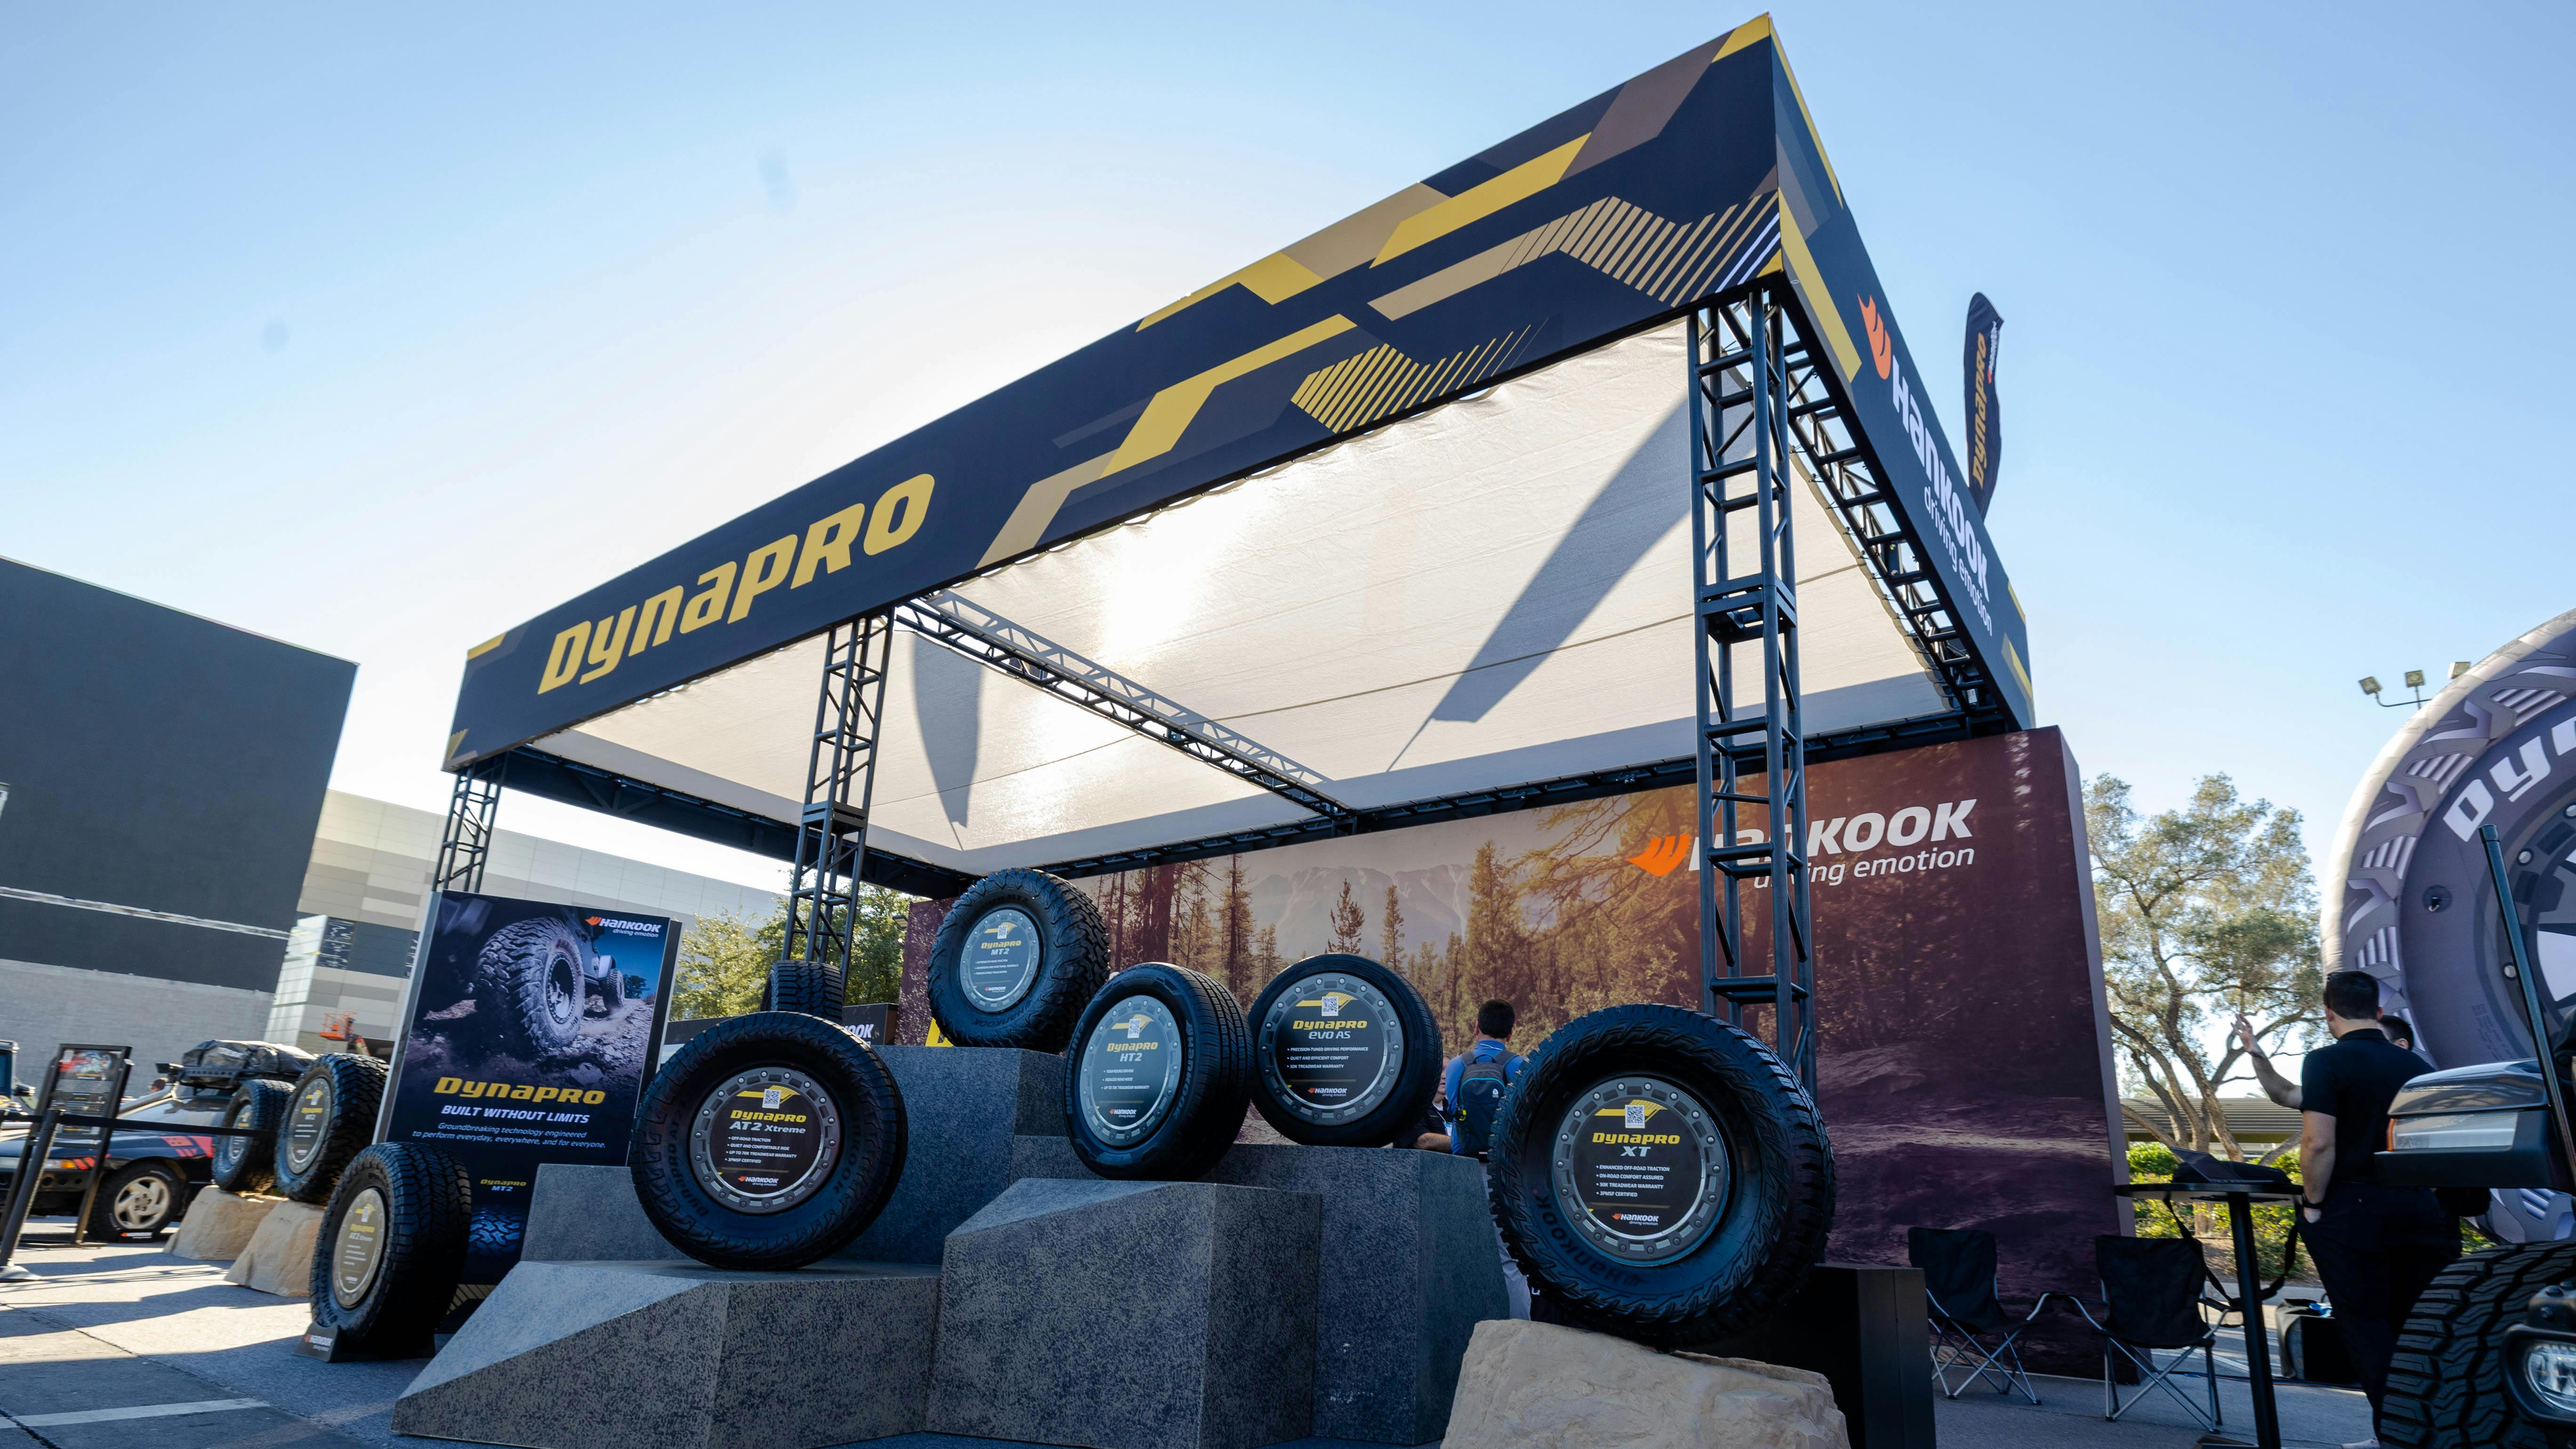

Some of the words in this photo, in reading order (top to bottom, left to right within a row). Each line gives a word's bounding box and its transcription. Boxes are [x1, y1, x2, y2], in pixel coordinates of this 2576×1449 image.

[1923, 485, 1958, 574] driving
[1958, 557, 1993, 637] emotion
[1853, 847, 1975, 879] emotion
[1336, 1031, 1352, 1039] AS
[1119, 1053, 1143, 1062] HT2
[441, 1105, 483, 1116] BUILT
[483, 1108, 546, 1121] WITHOUT
[546, 1112, 590, 1124] LIMITS
[438, 1122, 500, 1135] Groundbreaking
[501, 1127, 544, 1137] technology
[545, 1129, 587, 1139] engineered
[729, 1121, 763, 1131] AT2
[764, 1125, 806, 1134] Xtreme
[422, 1131, 455, 1140] perform
[456, 1133, 493, 1143] everyday,
[495, 1135, 540, 1145] everywhere,
[558, 1139, 570, 1147] for
[571, 1141, 606, 1149] everyone.
[1620, 1146, 1651, 1157] XT
